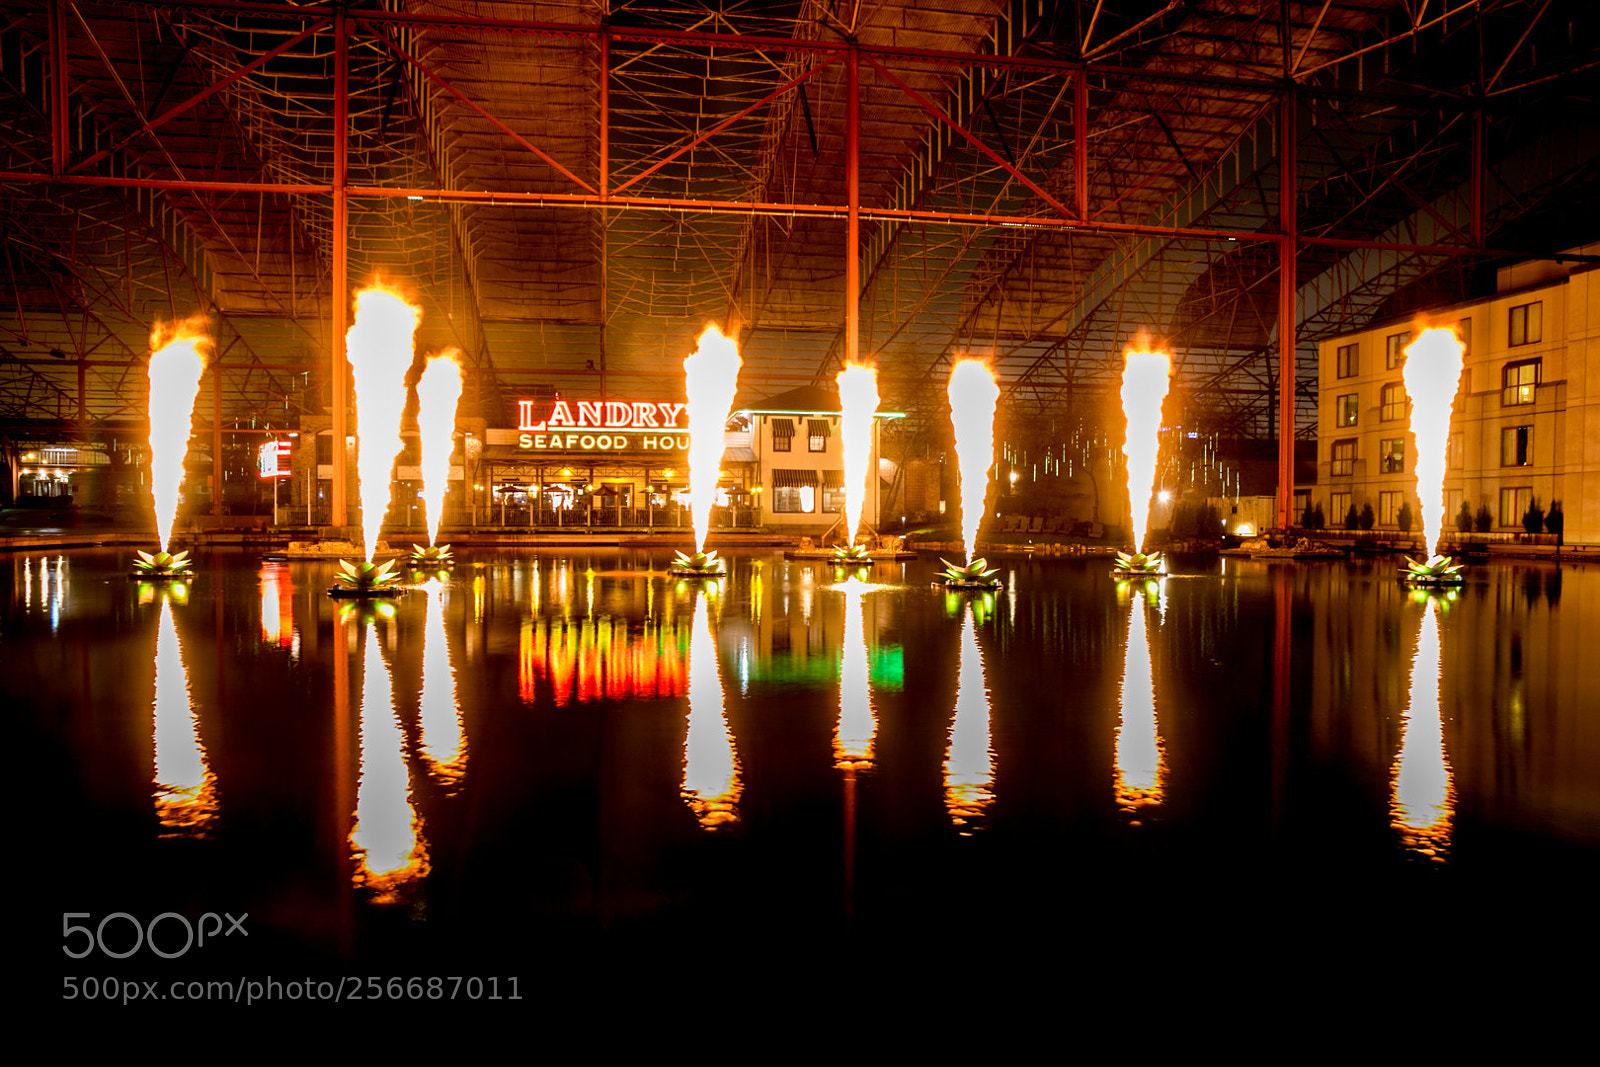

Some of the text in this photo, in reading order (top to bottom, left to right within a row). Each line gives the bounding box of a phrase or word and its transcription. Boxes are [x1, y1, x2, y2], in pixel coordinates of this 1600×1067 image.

[518, 400, 689, 431] LANDRY
[519, 434, 689, 450] SEAFOOD HOU
